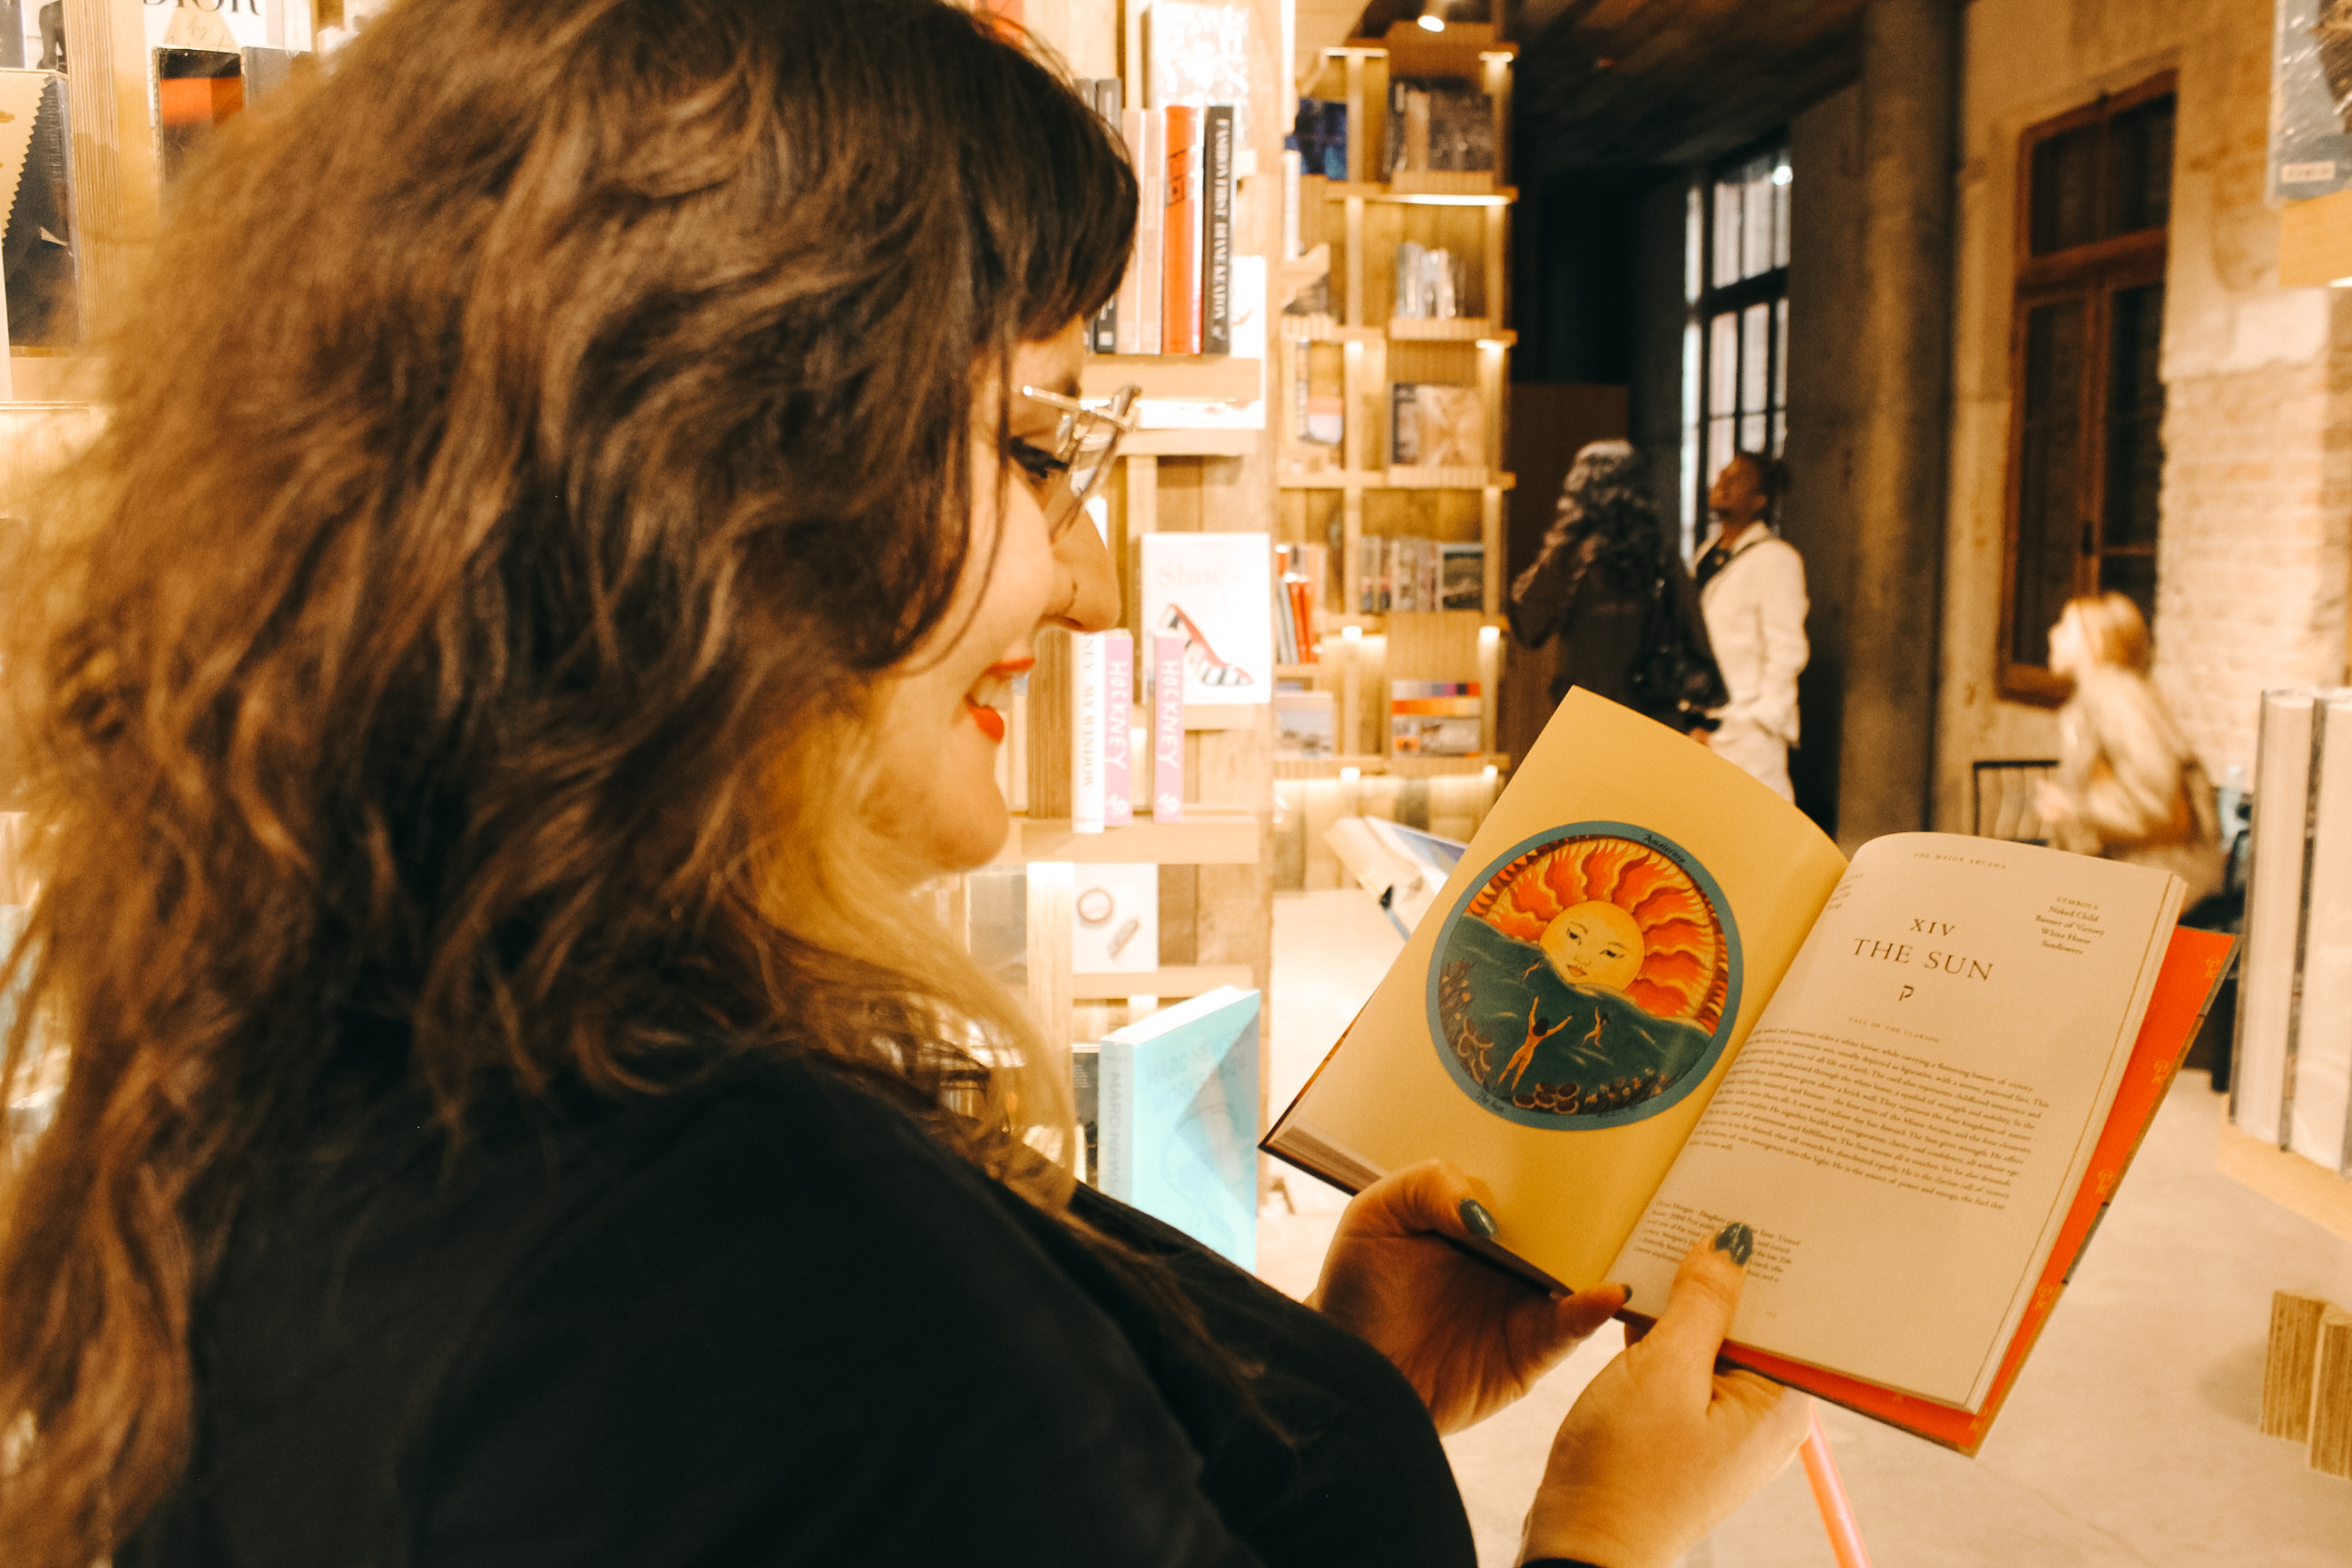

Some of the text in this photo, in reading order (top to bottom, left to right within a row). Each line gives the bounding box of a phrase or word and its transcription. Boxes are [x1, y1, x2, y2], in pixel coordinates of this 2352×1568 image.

[1083, 684, 1095, 709] MY
[1106, 660, 1131, 770] HOCKNEY
[1157, 659, 1181, 769] HOCKNEY
[1083, 714, 1095, 789] WINDOW
[1968, 859, 2006, 868] ARCANA
[2048, 906, 2099, 922] Naked Child
[2056, 897, 2099, 910] SYMBOLS
[1908, 917, 1957, 937] XIV
[2034, 915, 2062, 926] Banner
[2076, 922, 2105, 938] Victory
[2041, 927, 2092, 945] White Horse
[2041, 940, 2083, 955] Sunflowers
[1853, 936, 1994, 982] THE SUN
